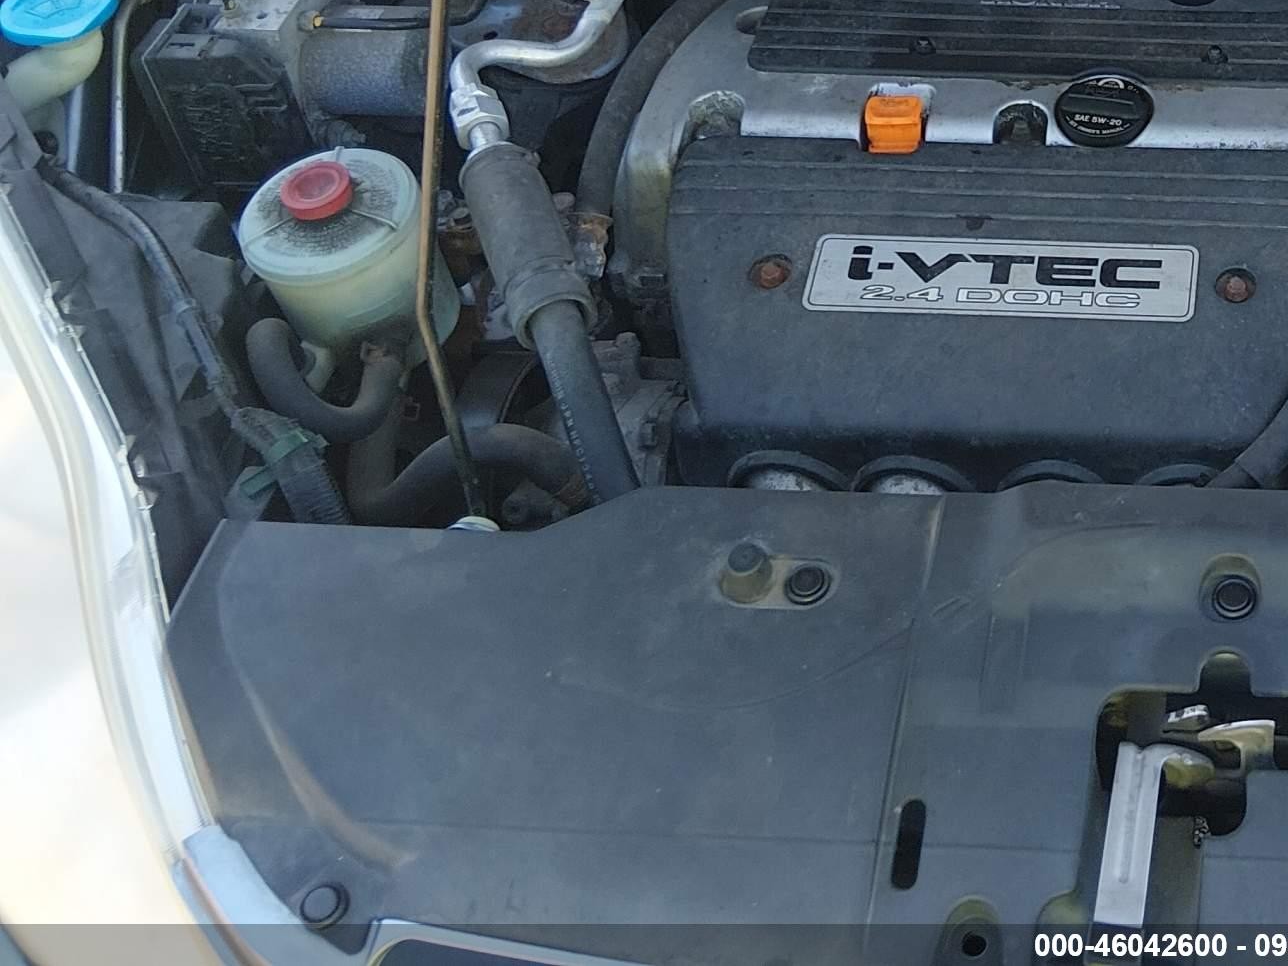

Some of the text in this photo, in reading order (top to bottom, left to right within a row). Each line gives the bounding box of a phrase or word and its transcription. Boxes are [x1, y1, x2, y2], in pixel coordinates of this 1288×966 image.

[1073, 114, 1090, 122] SAE
[847, 245, 1162, 289] i-VTEC
[860, 284, 1142, 309] 2.4 DOHC
